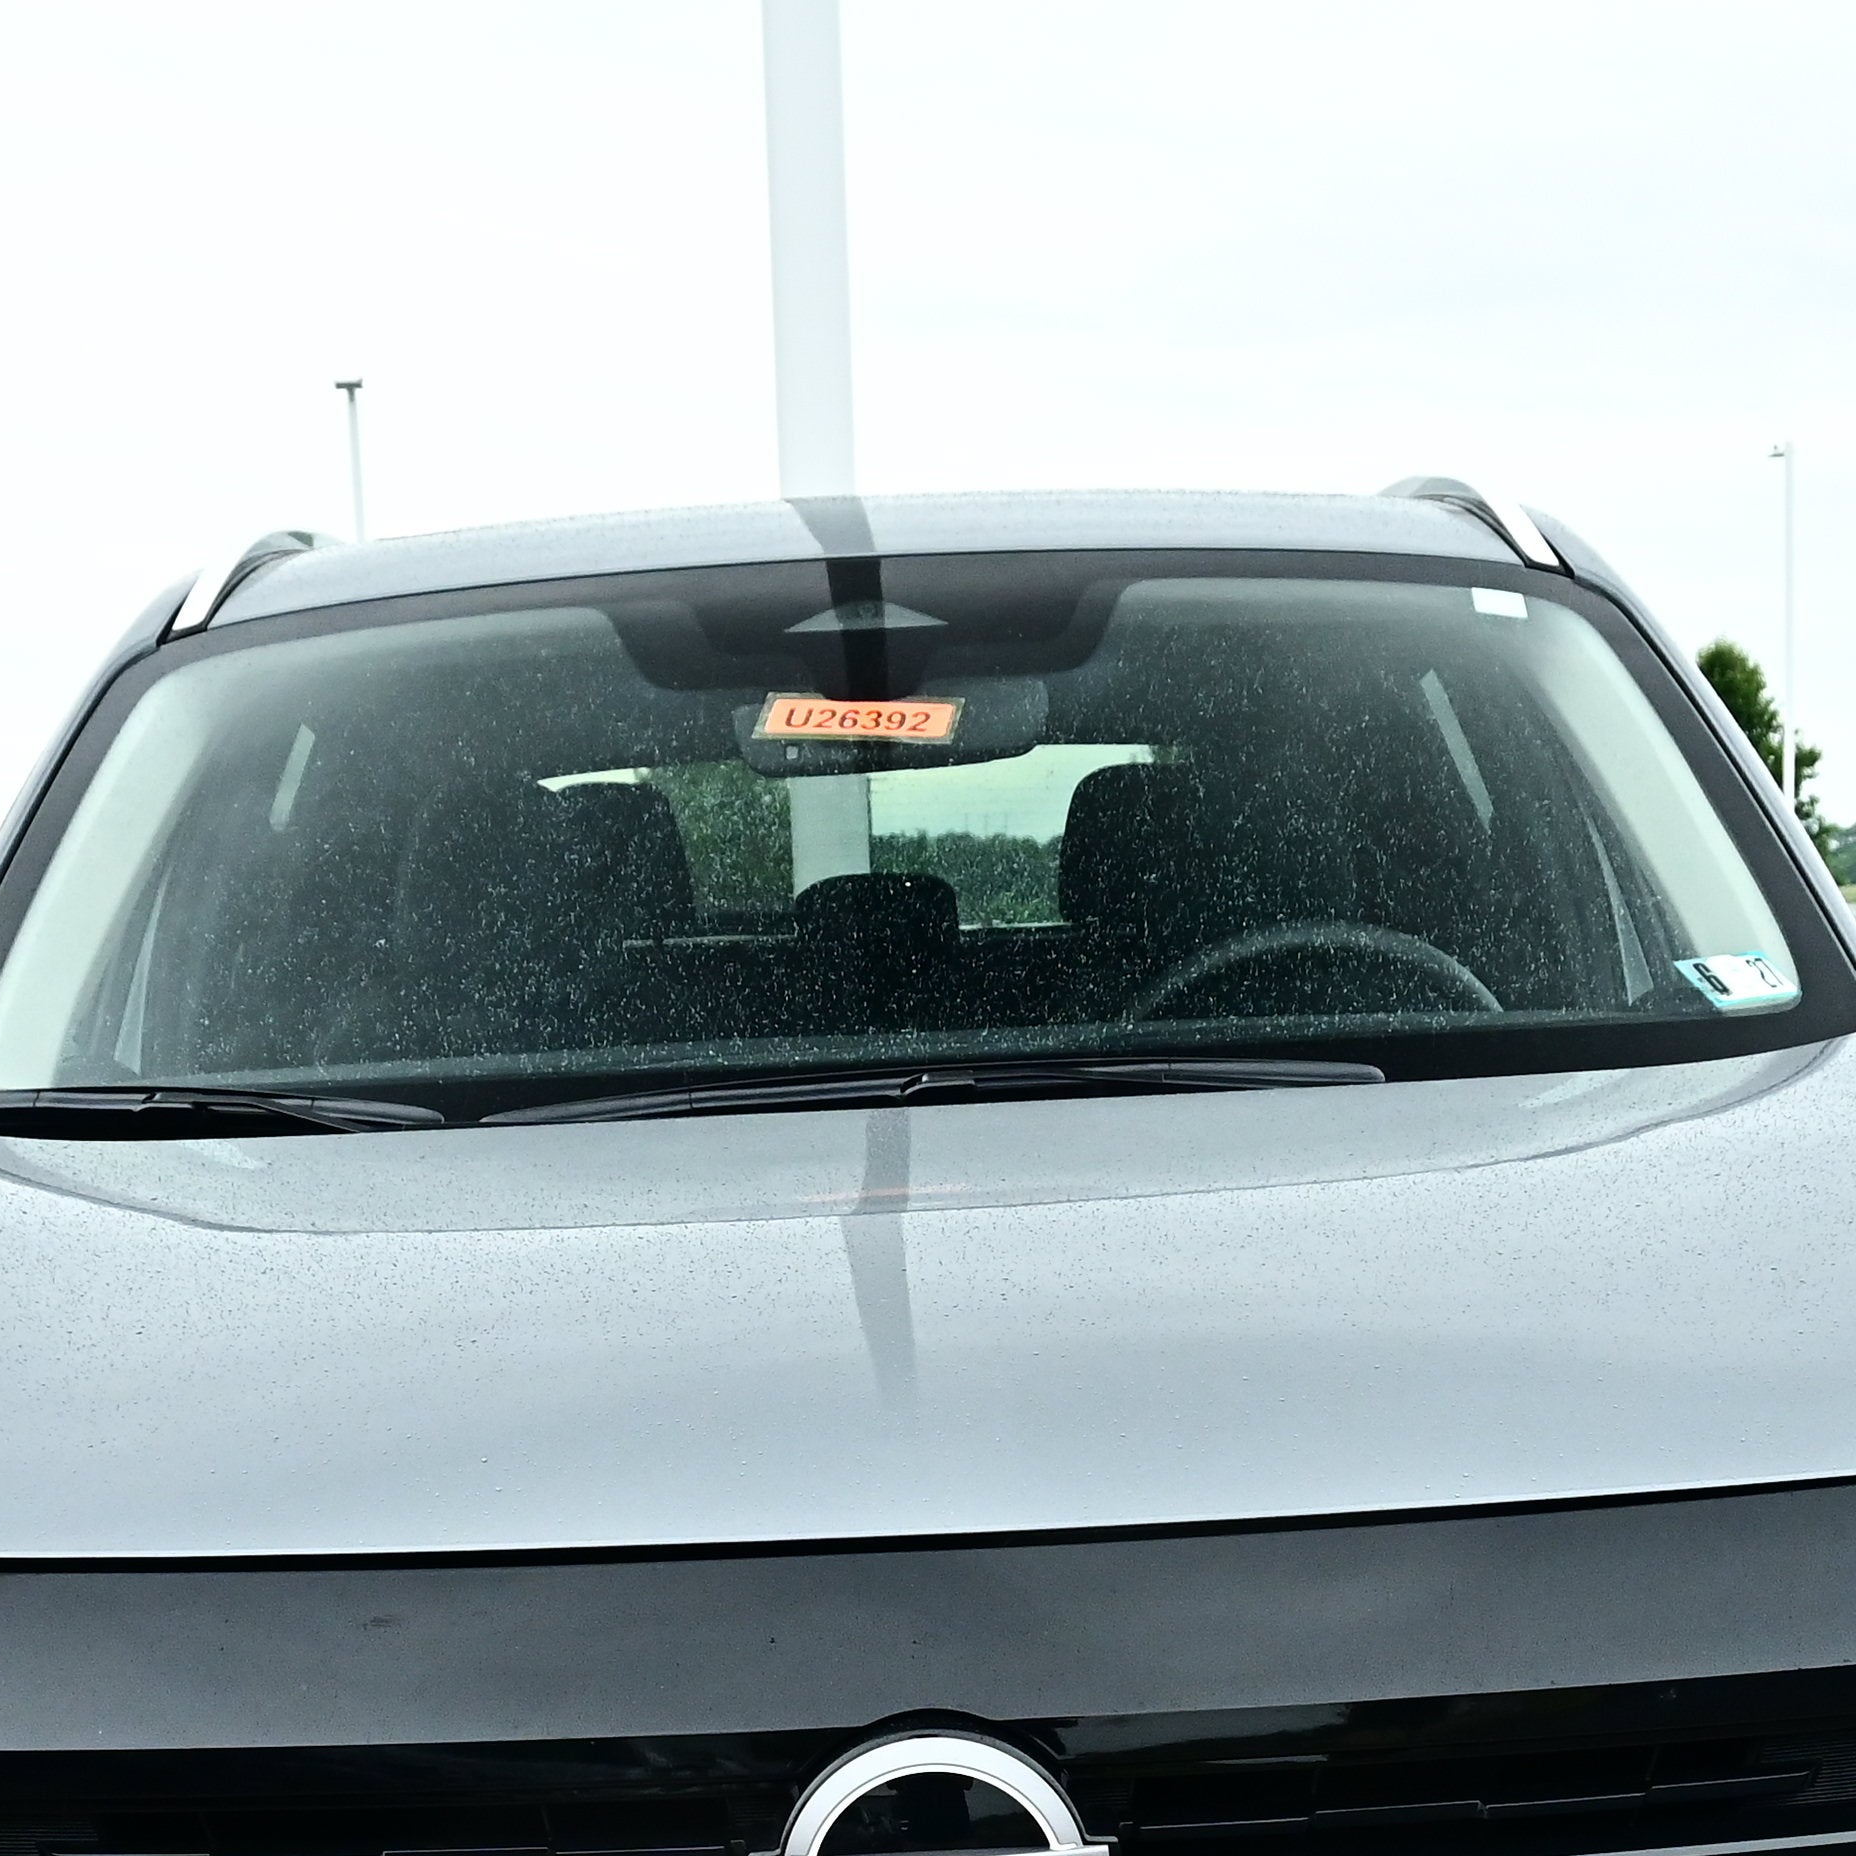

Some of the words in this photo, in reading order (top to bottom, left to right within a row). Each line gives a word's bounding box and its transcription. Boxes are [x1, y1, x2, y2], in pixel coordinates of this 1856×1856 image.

[784, 707, 931, 732] U26392
[1692, 962, 1732, 996] 6
[1745, 957, 1784, 988] 27
